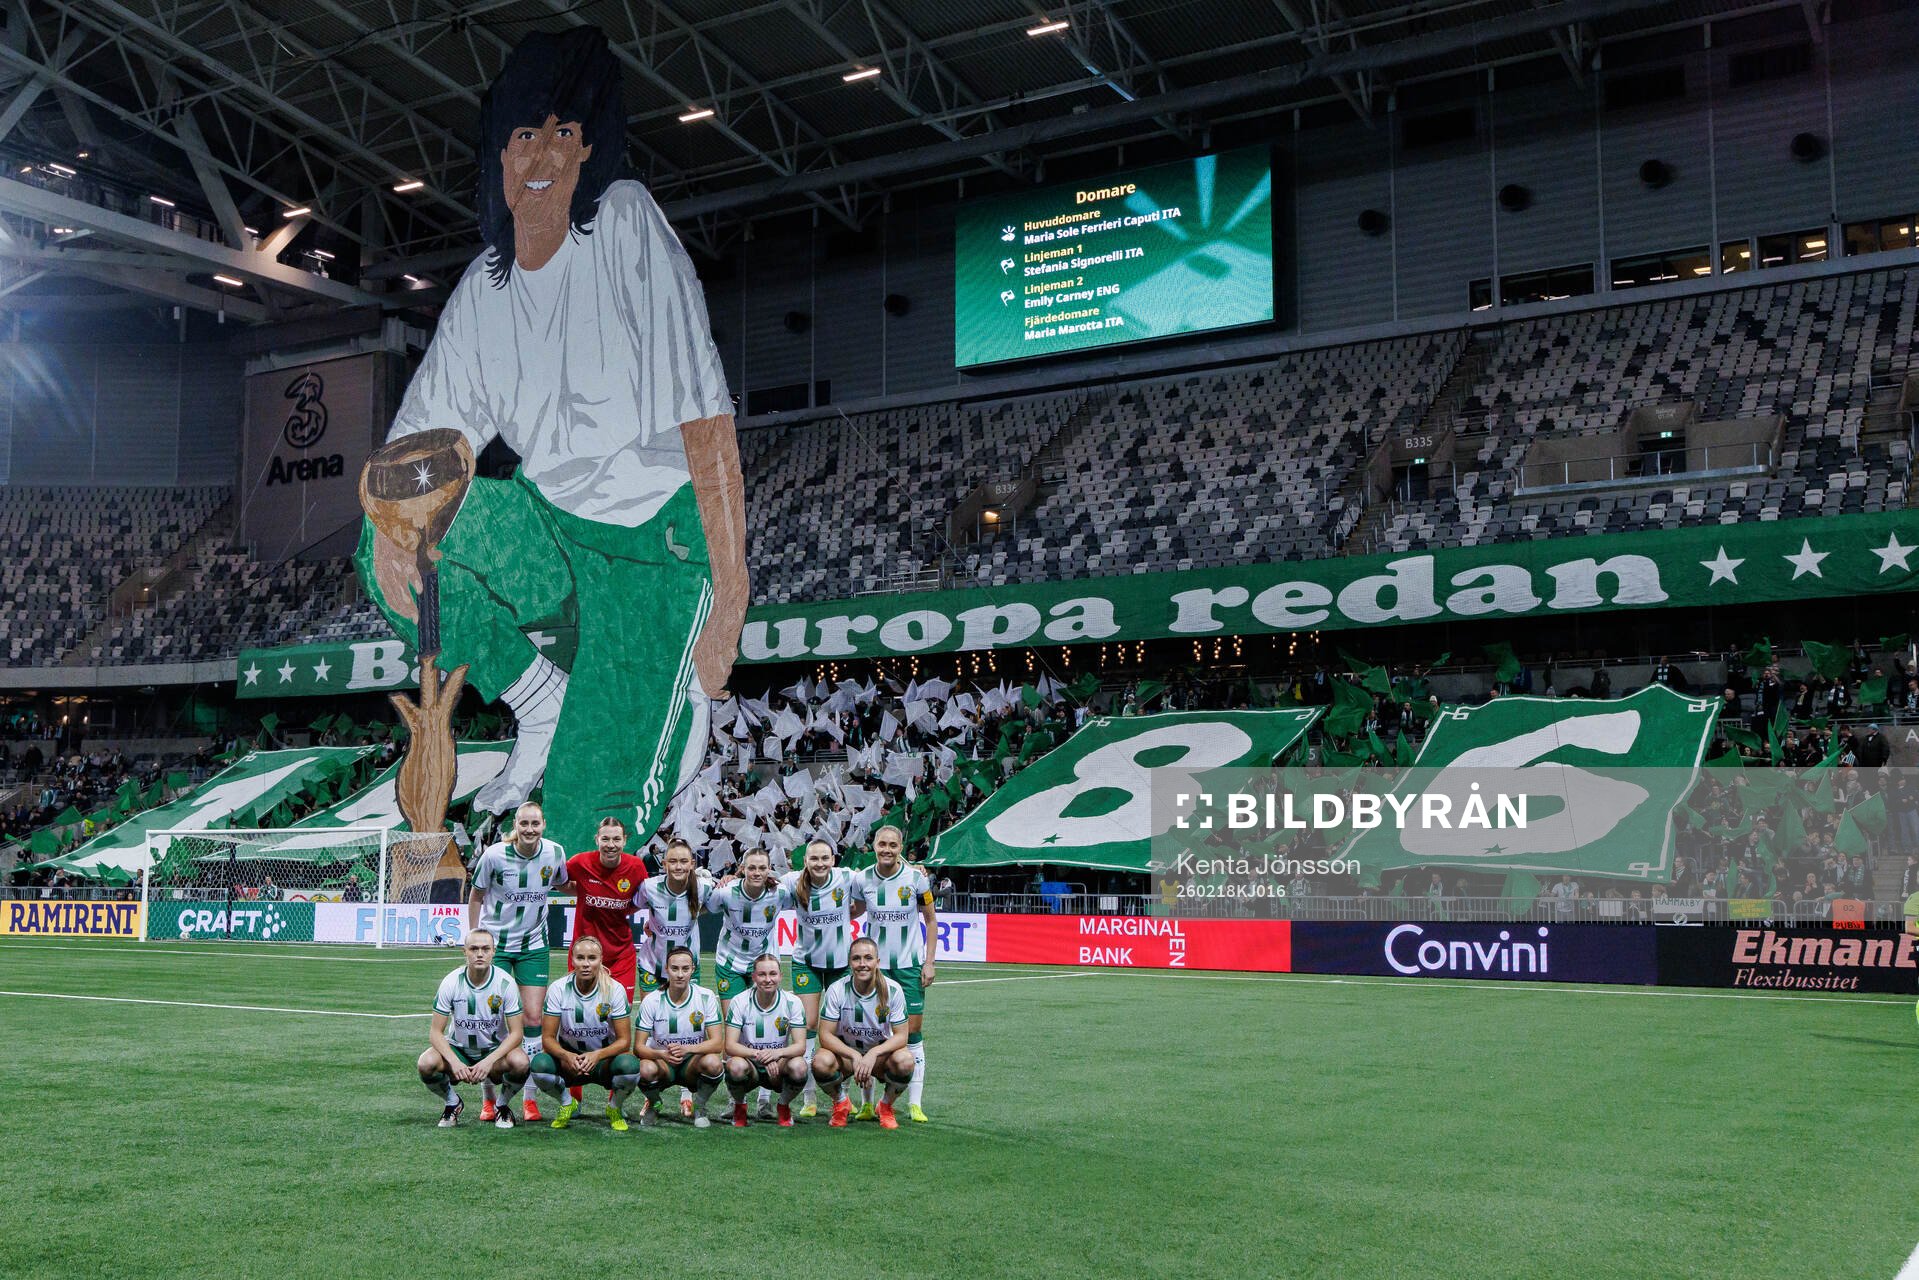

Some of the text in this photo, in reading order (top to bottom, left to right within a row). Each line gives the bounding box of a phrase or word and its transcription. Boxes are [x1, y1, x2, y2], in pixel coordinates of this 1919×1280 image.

[1076, 183, 1136, 204] Domare
[1024, 210, 1101, 231] Huvuddomare
[1024, 207, 1181, 245] Maria Sole Ferrieri Caputi ITA
[1024, 244, 1083, 264] Linjeman 1
[1024, 247, 1144, 277] Stefania Signorelli ITA
[1024, 276, 1083, 296] Linjeman 2
[1024, 284, 1120, 309] Emily Carney ENG
[1024, 307, 1099, 328] Fjärdedomare
[1024, 316, 1124, 340] Maria Marotta ITA
[266, 454, 344, 487] Arena
[740, 554, 1669, 660] uropa redan
[985, 722, 1252, 848] 8
[1400, 710, 1649, 856] 6
[9, 904, 137, 934] RAMIRENT
[178, 908, 262, 932] CRAFT
[1079, 946, 1133, 965] BANK
[1384, 923, 1549, 974] Convini
[1734, 968, 1860, 990] Flexibussitet
